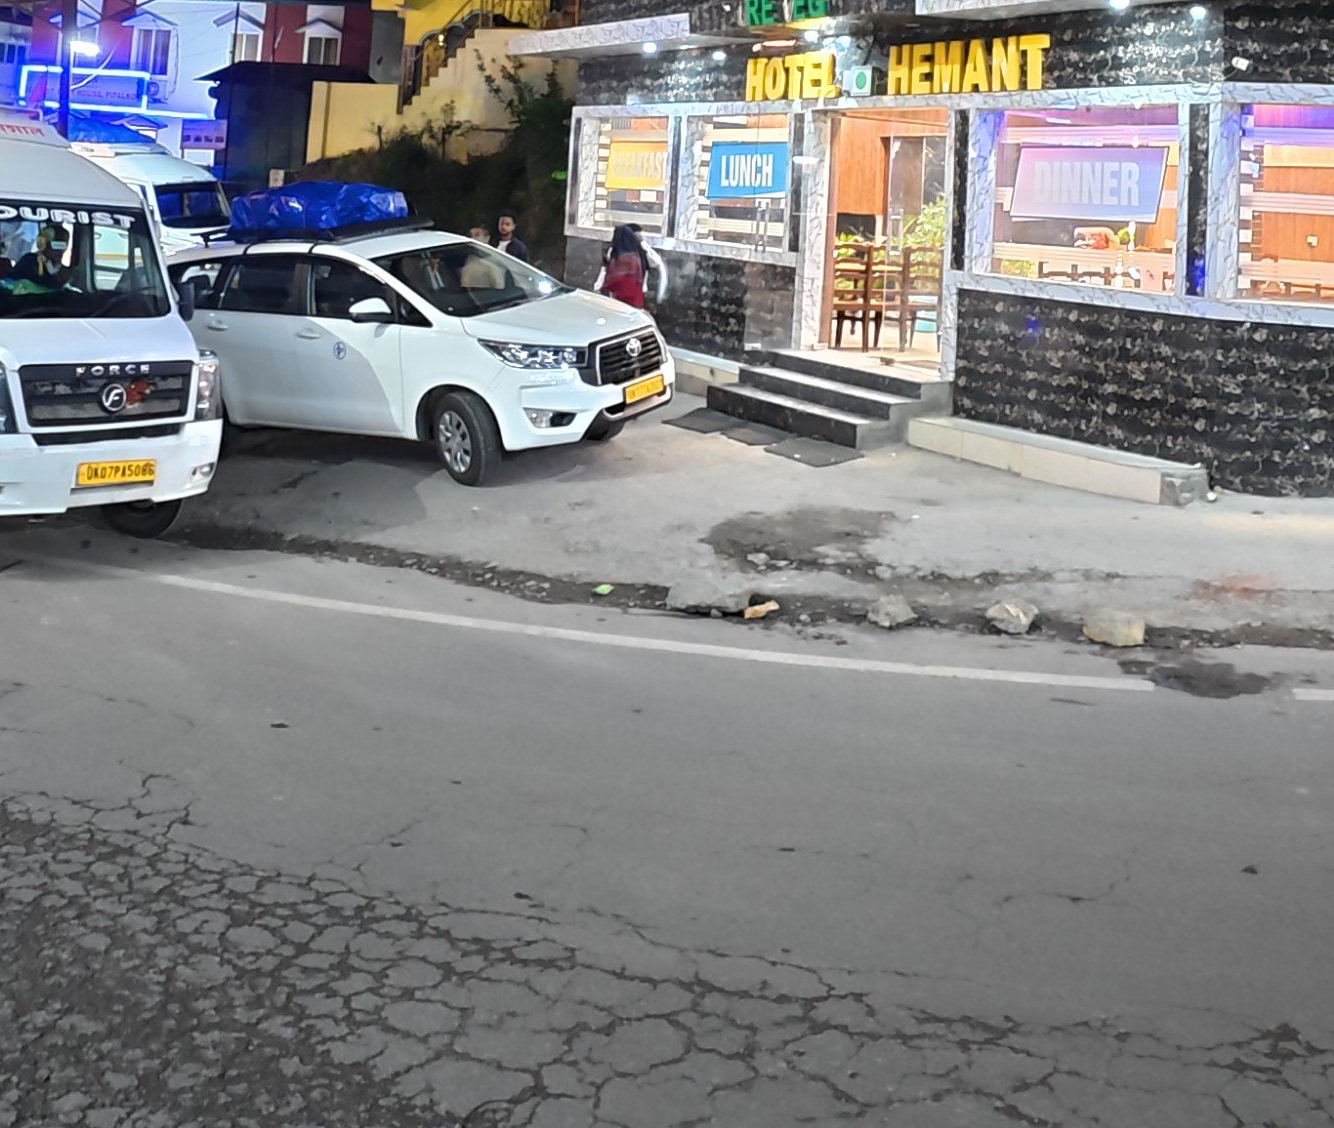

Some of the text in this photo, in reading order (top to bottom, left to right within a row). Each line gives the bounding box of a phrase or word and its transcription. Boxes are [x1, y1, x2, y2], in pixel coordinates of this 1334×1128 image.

[746, 34, 1051, 102] HOTEL HEMANT
[720, 153, 775, 188] LUNCH
[1033, 160, 1141, 207] DINNER
[74, 364, 151, 377] FORCE
